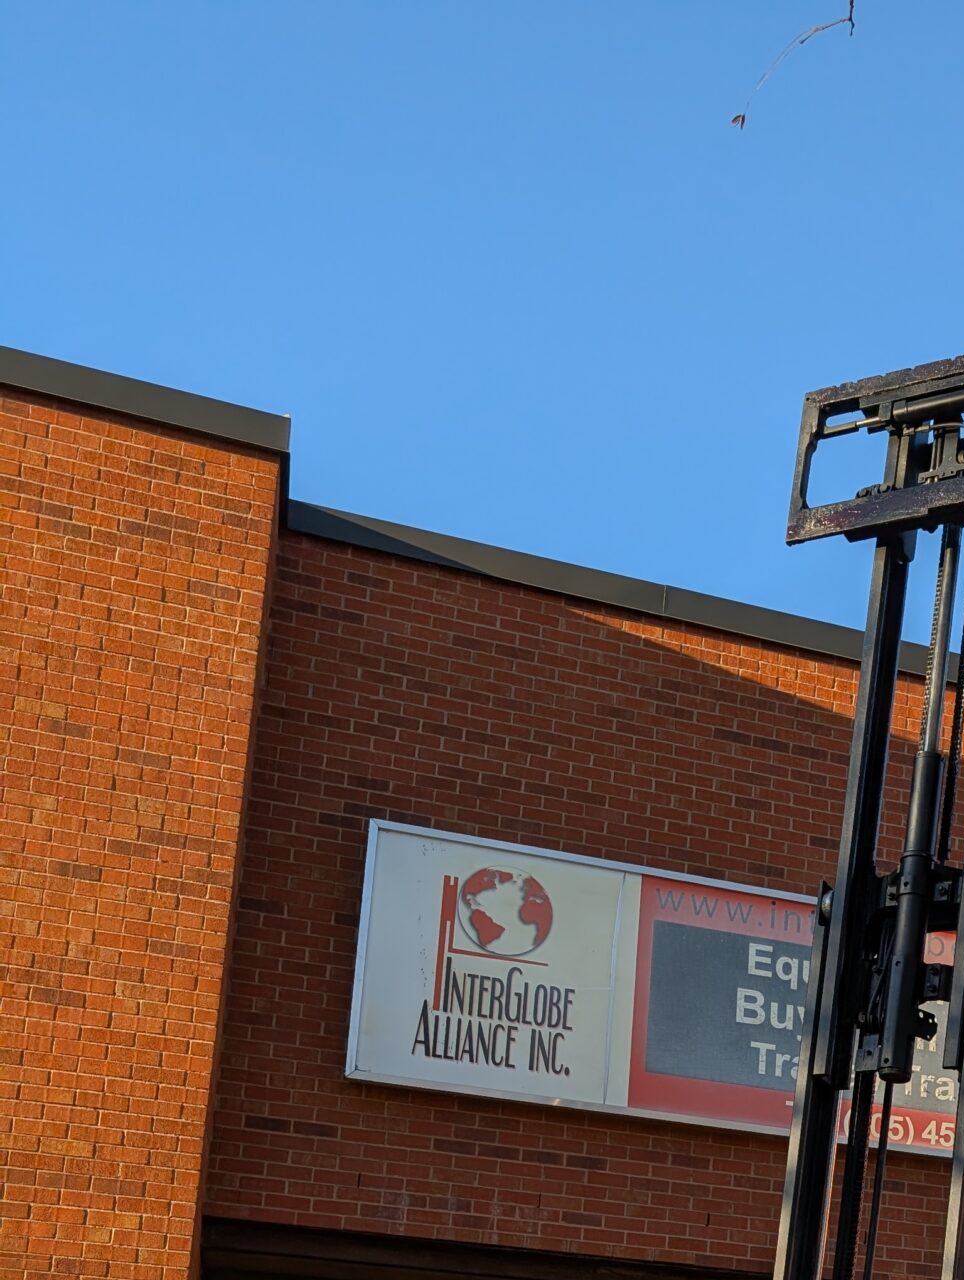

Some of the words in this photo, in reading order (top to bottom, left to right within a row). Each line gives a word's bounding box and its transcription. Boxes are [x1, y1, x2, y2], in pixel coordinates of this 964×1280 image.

[411, 1000, 518, 1070] ALLIANCE
[528, 1028, 571, 1077] INC.
[843, 1109, 915, 1146] (05)
